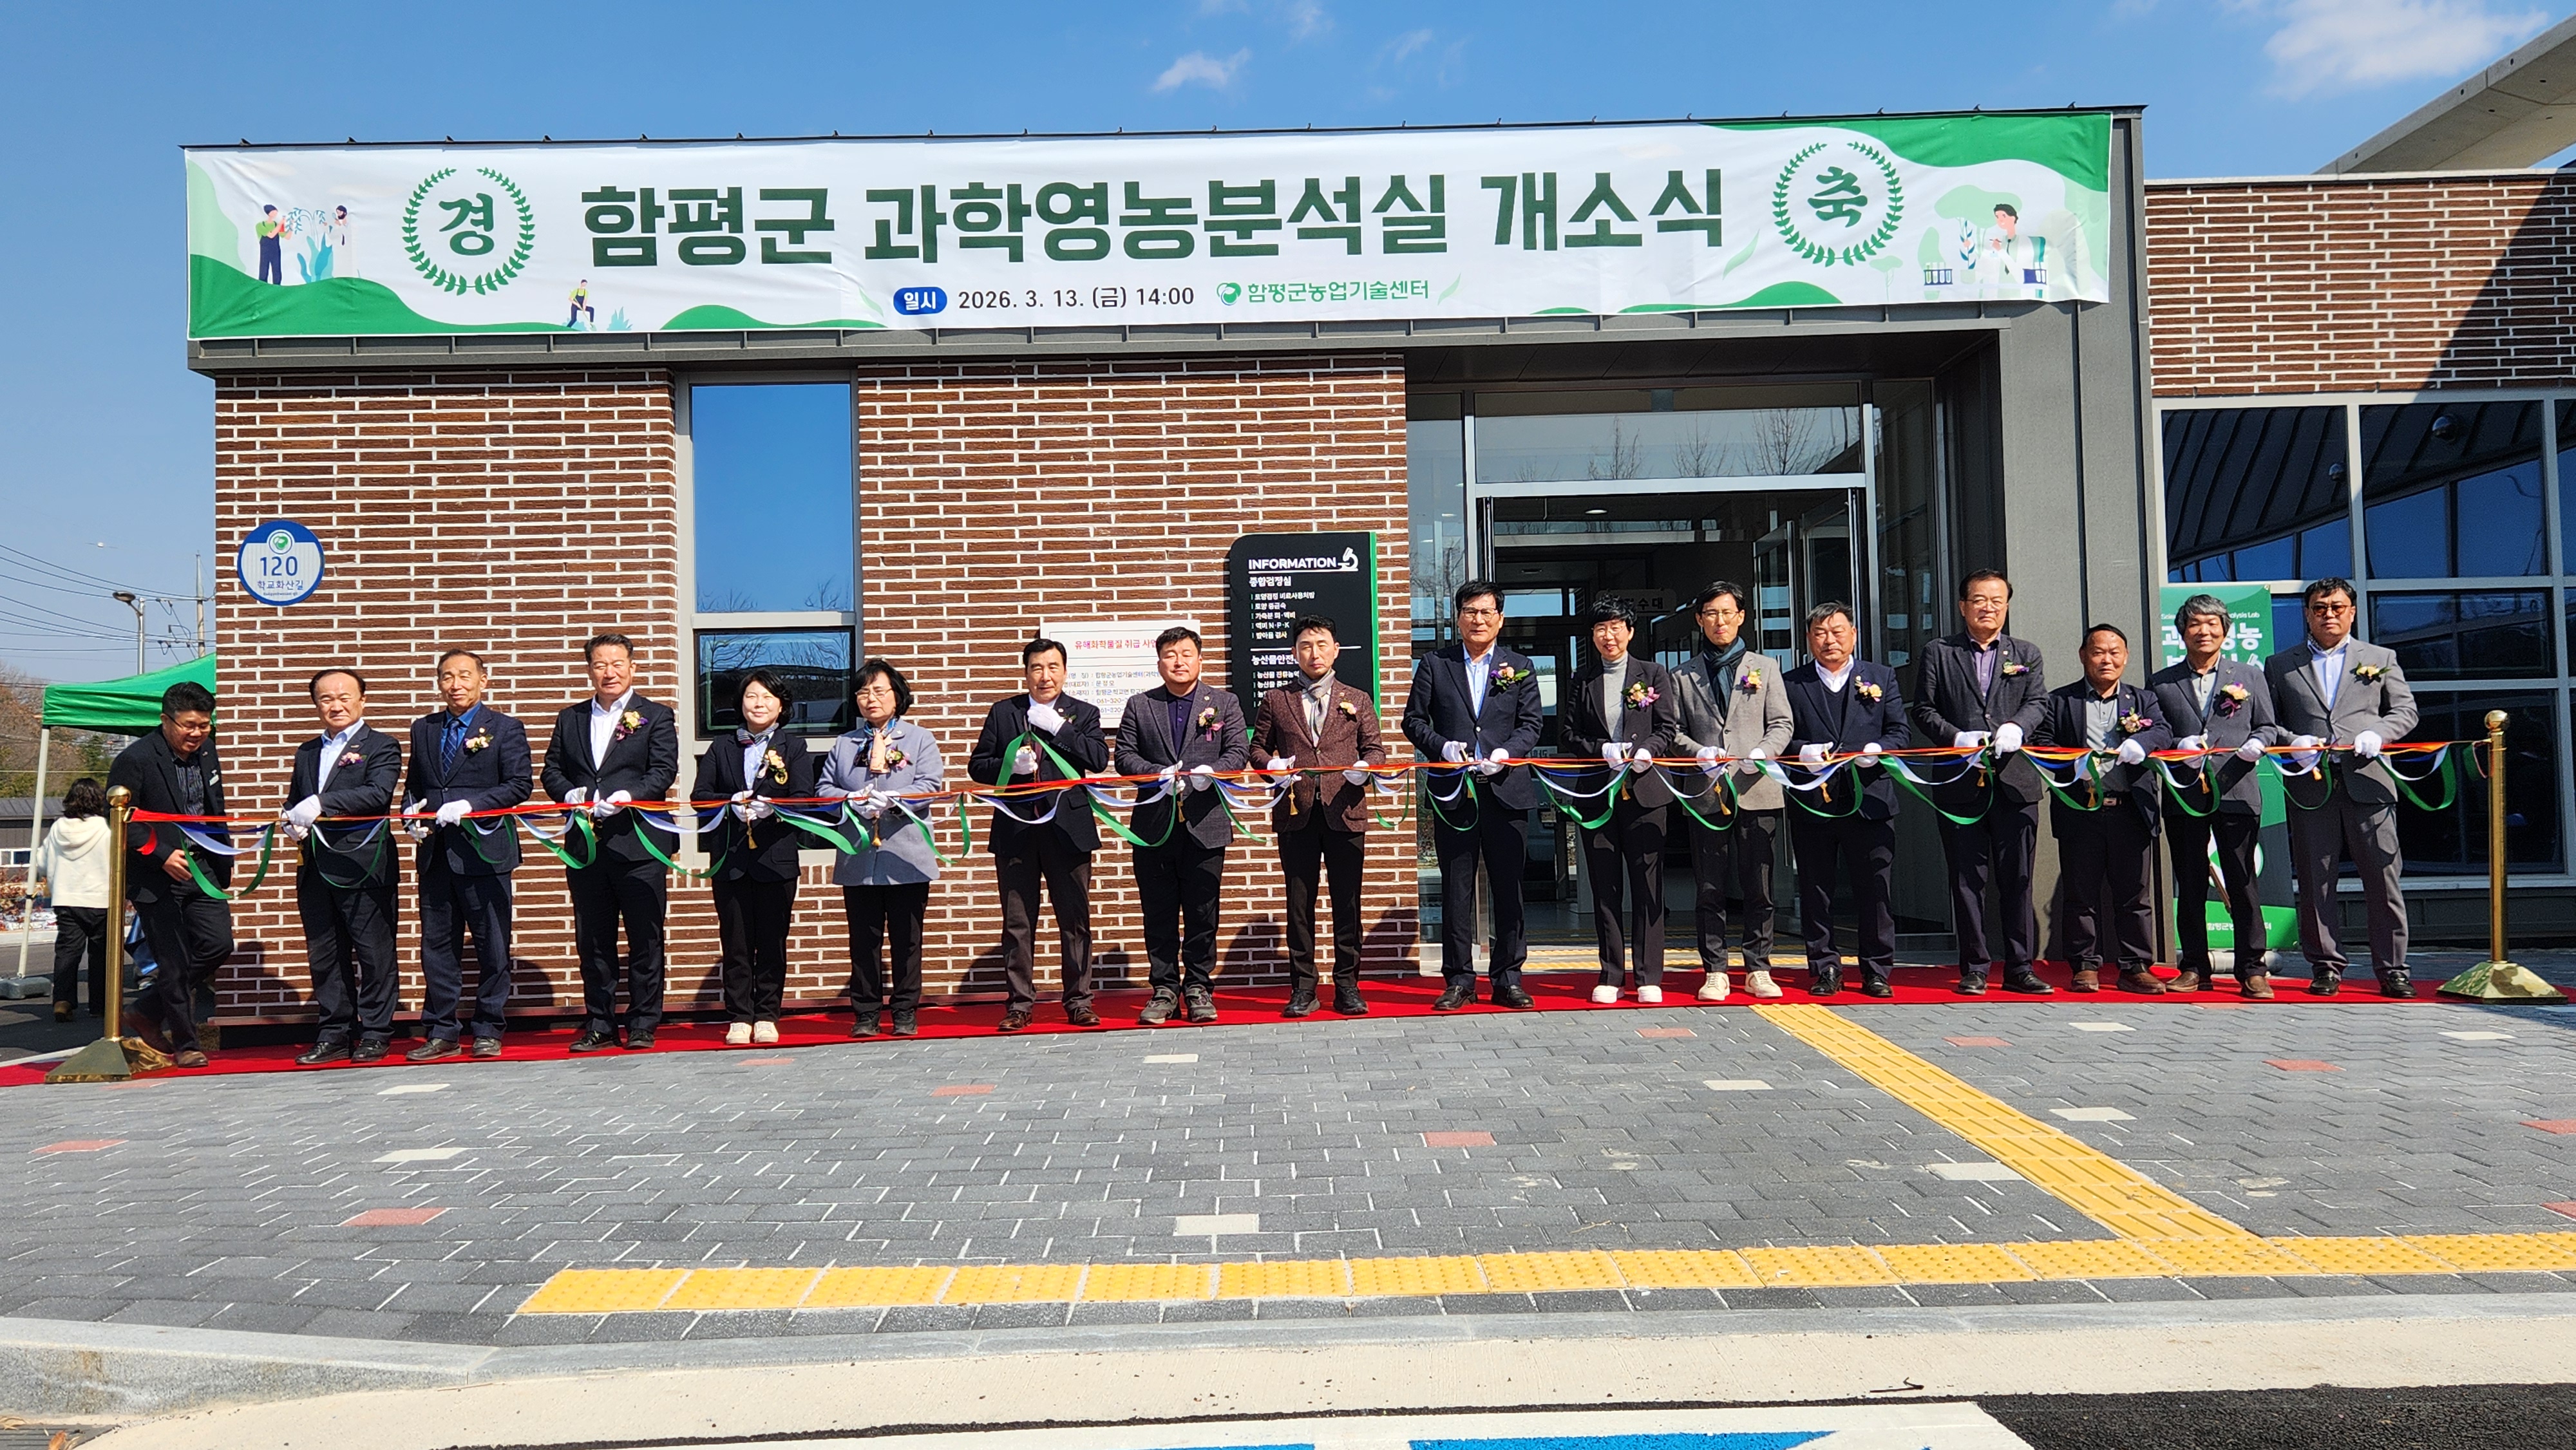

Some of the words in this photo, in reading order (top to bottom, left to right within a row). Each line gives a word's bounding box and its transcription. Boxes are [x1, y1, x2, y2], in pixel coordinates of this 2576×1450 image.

[1807, 165, 1868, 228] 축
[439, 193, 495, 256] 경
[582, 184, 835, 267] 함평군
[865, 174, 1447, 263] 과학영농분석실
[1481, 169, 1722, 251] 개소식
[903, 292, 937, 310] 일시
[958, 290, 1018, 310] 2026.
[1026, 290, 1044, 308] 3.
[1055, 289, 1084, 308] 13.
[1092, 286, 1127, 310] (금)
[1137, 287, 1195, 306] 14:00
[1248, 279, 1429, 305] 함평군농업기술센터
[260, 556, 298, 577] 120
[1248, 557, 1336, 570] INFORMATION
[257, 579, 304, 590] 학교화산길
[1249, 576, 1292, 587] 종합검정실
[1075, 639, 1122, 650] 유해화학물질
[1124, 639, 1141, 648] 취급
[1251, 654, 1299, 665] 농산물안전
